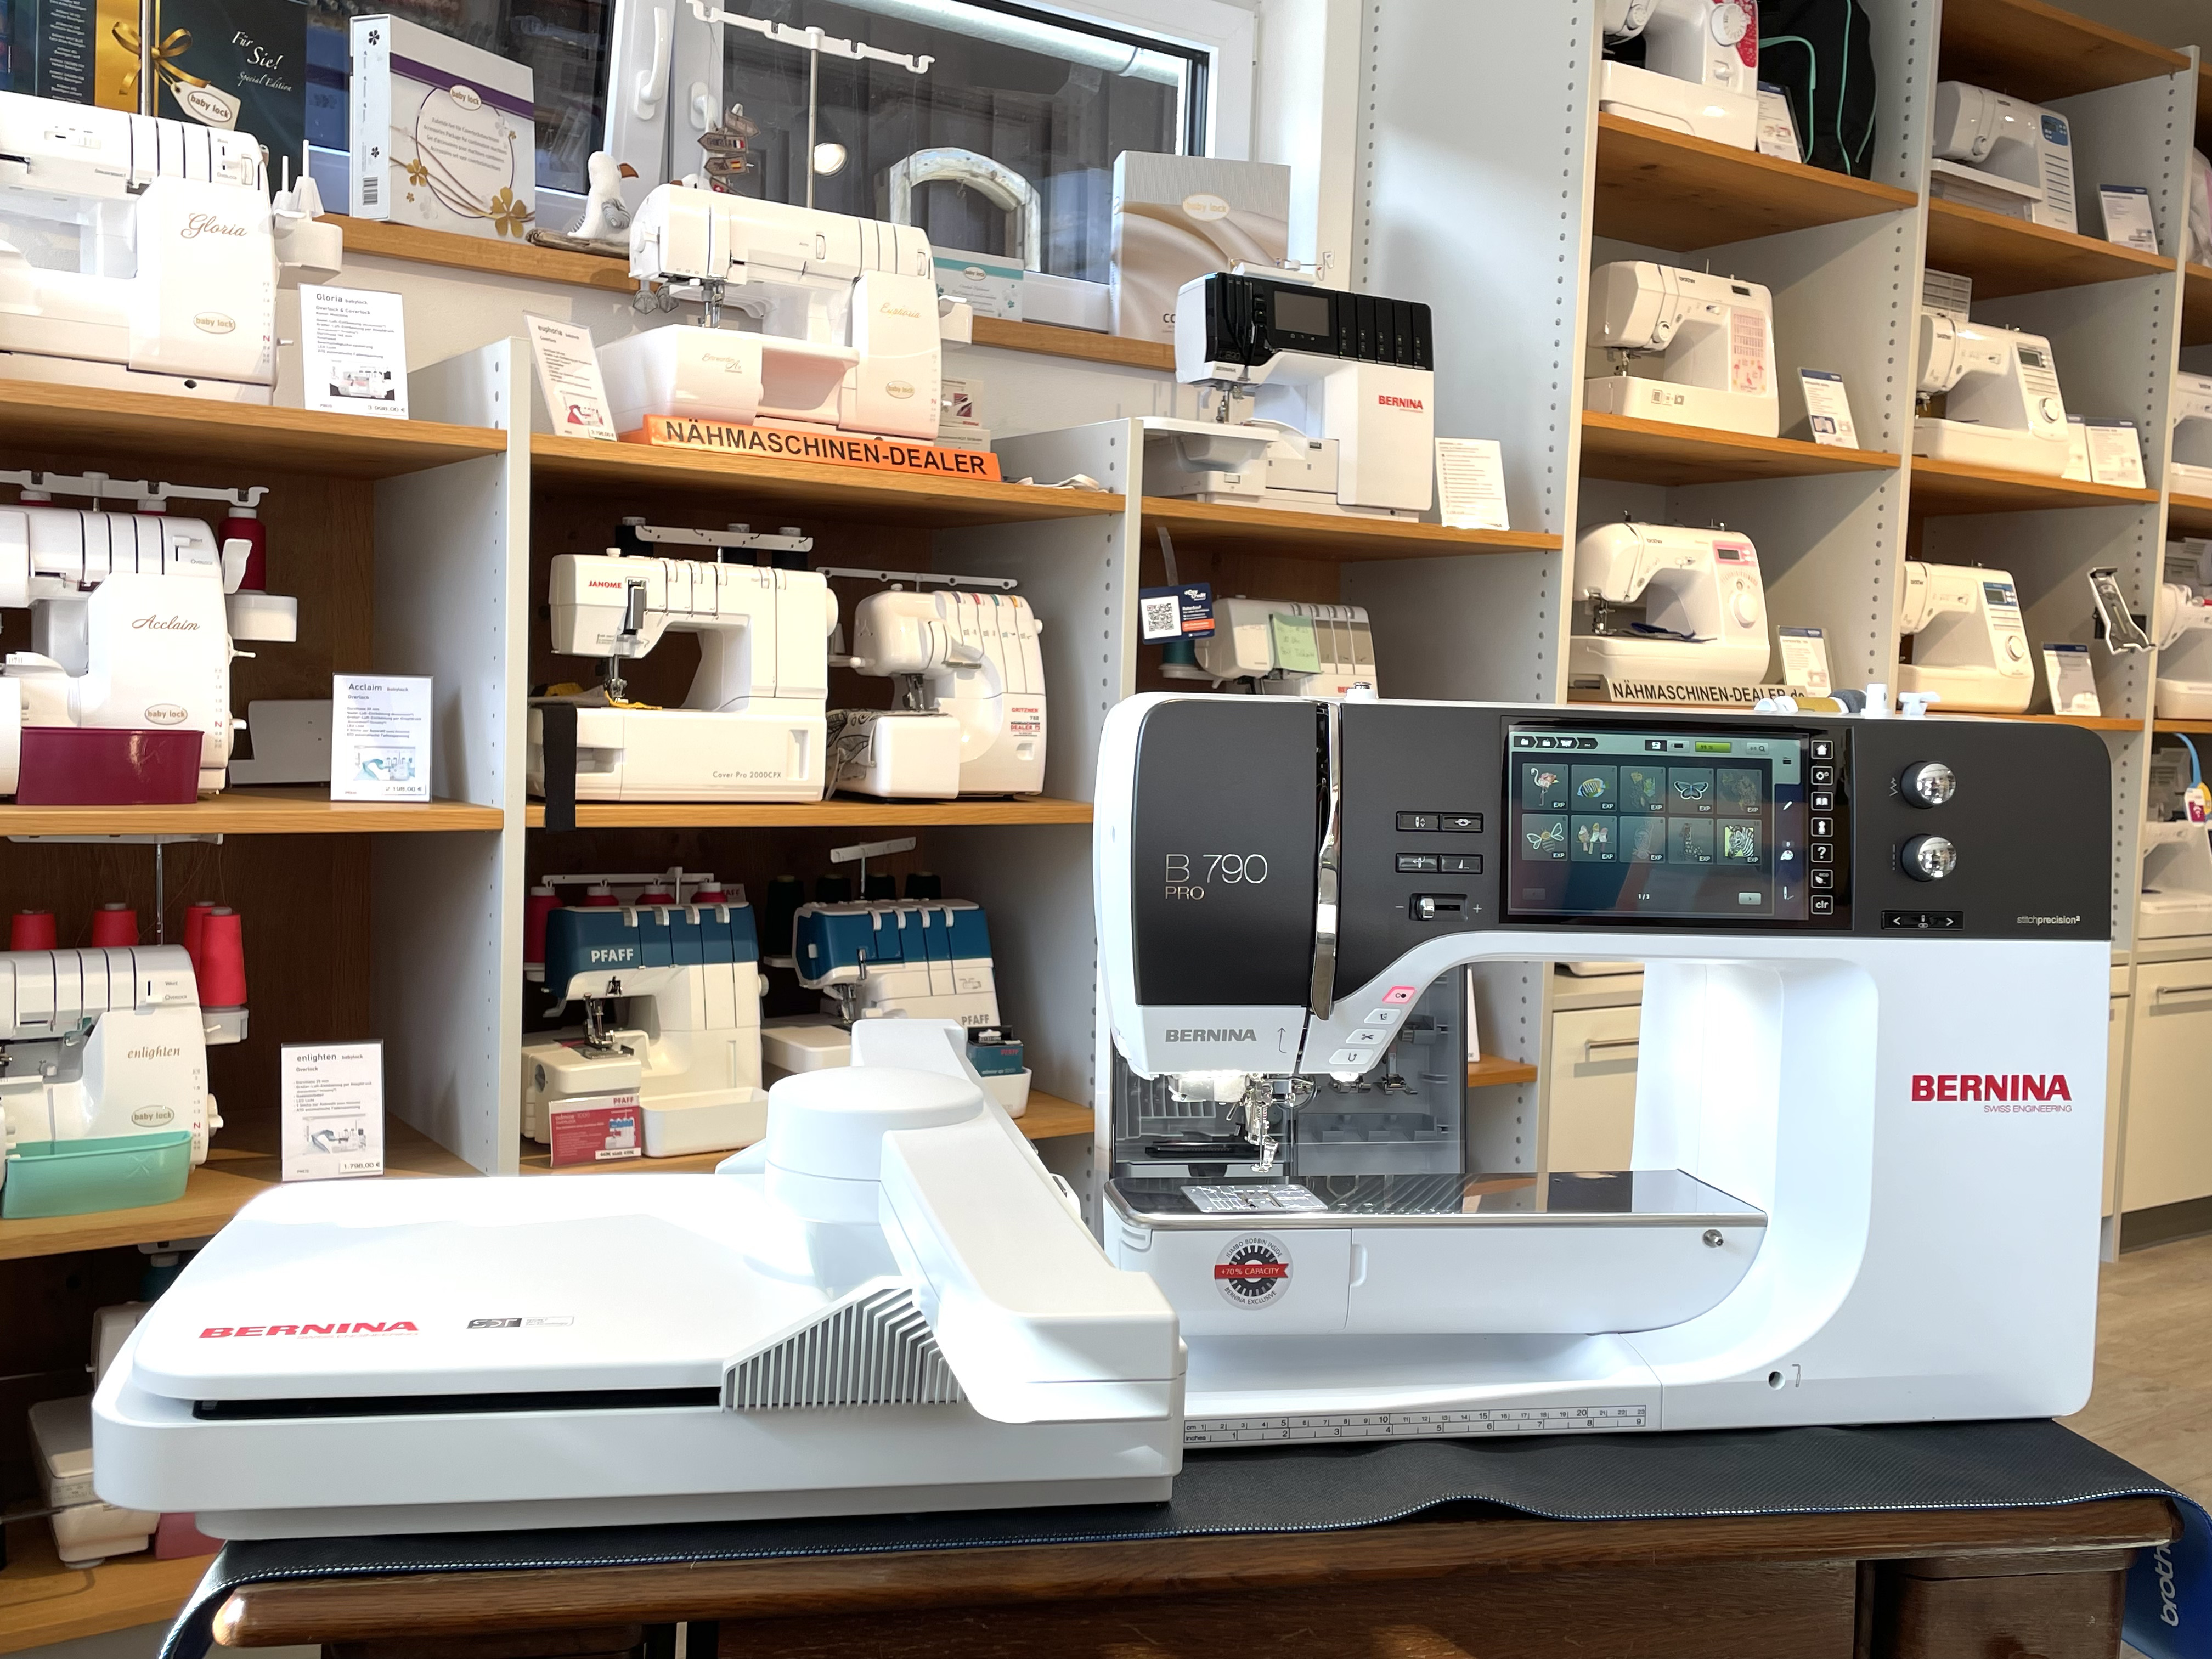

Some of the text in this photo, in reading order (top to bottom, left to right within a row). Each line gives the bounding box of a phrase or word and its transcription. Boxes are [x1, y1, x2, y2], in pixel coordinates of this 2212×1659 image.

[232, 31, 253, 47] Für
[247, 46, 284, 70] Sie!
[238, 71, 267, 87] Special
[191, 95, 229, 119] baby lock
[181, 213, 247, 239] Gloria
[316, 293, 342, 303] Gloria
[196, 317, 233, 328] baby lock
[1379, 395, 1424, 410] BERNINA
[665, 418, 986, 475] NÄHMASCHINEN-DEALER
[588, 580, 623, 589] JANOME
[132, 614, 200, 631] Acclaim
[348, 683, 382, 691] Acclaim
[148, 710, 166, 719] baby
[713, 771, 781, 779] Cover Pro 2000CPX
[1166, 854, 1268, 884] B 790
[1165, 886, 1204, 900] PRO
[1815, 900, 1830, 910] clr
[591, 948, 634, 963] PFAFF
[961, 1014, 989, 1025] PFAFF
[1165, 1029, 1257, 1042] BERNINA
[128, 1045, 180, 1060] enlighten
[297, 1053, 336, 1062] enlighten
[1911, 1074, 2073, 1102] BERNINA
[134, 1113, 153, 1121] baby
[1226, 1242, 1244, 1259] JUMBO
[1267, 1242, 1283, 1257] INSIDE
[1224, 1286, 1277, 1305] BERNINA EXCLUSIVE
[199, 1321, 419, 1338] BERNINA
